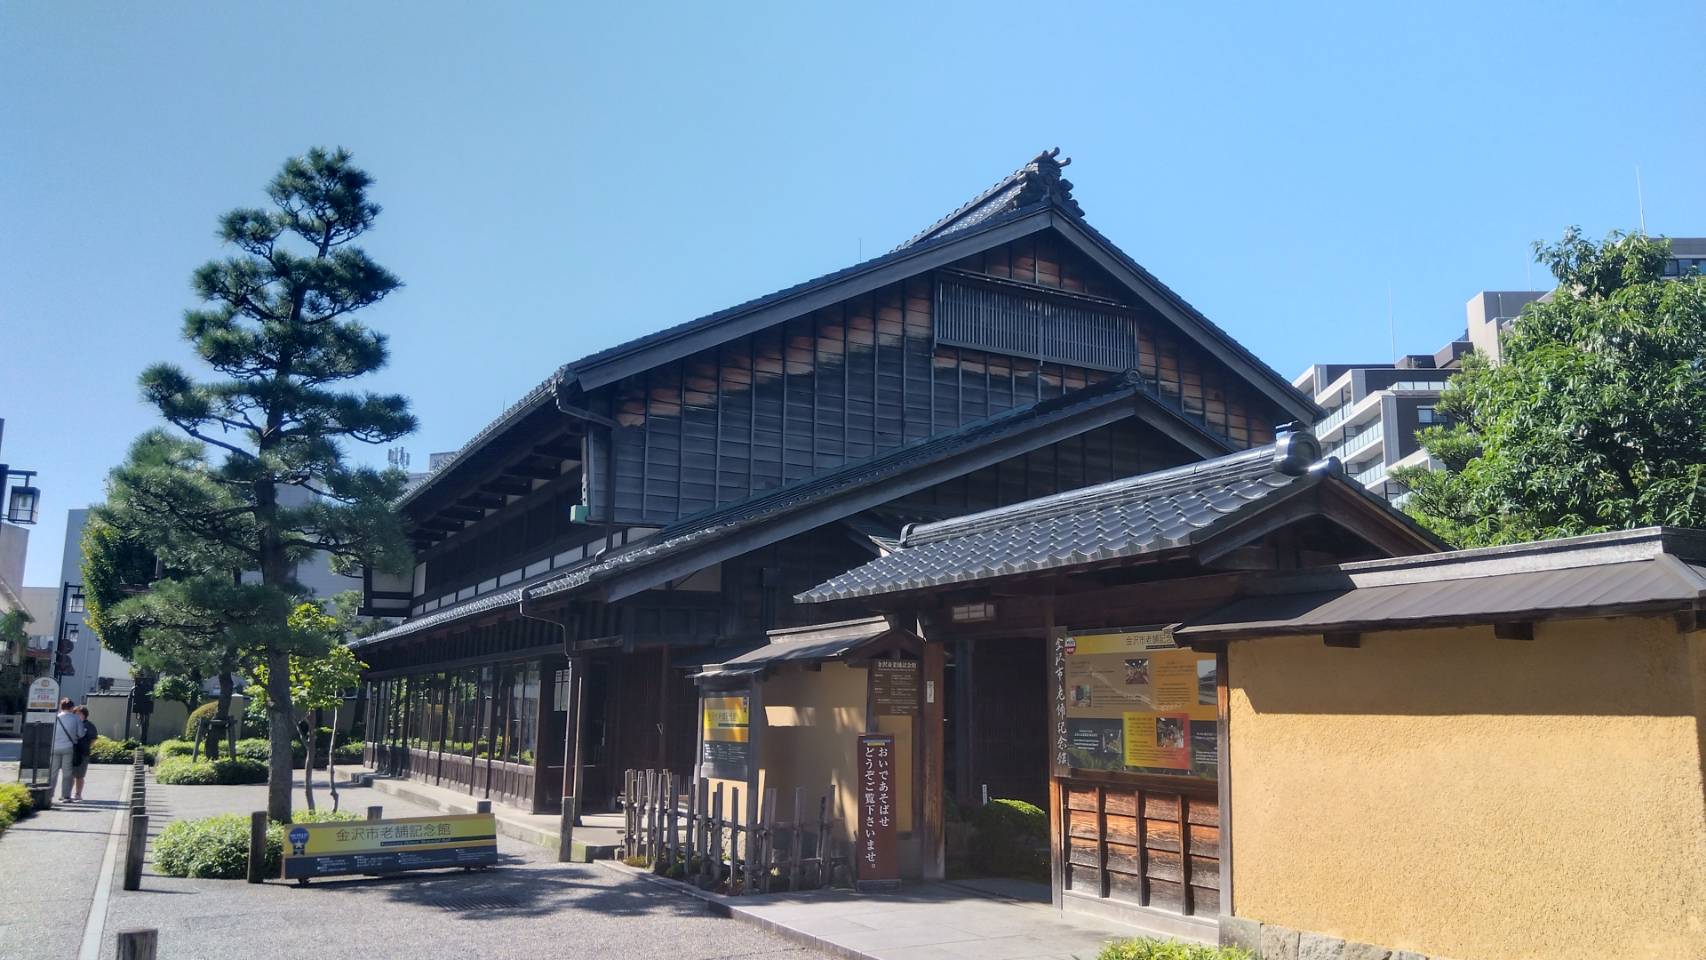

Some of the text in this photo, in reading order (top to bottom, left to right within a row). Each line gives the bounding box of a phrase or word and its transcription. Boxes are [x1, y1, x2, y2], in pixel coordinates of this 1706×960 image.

[865, 748, 876, 869] どうぞご覧下さいませ。
[879, 748, 889, 826] おいであそばせ
[336, 823, 451, 841] 金沢市老舗記念館
